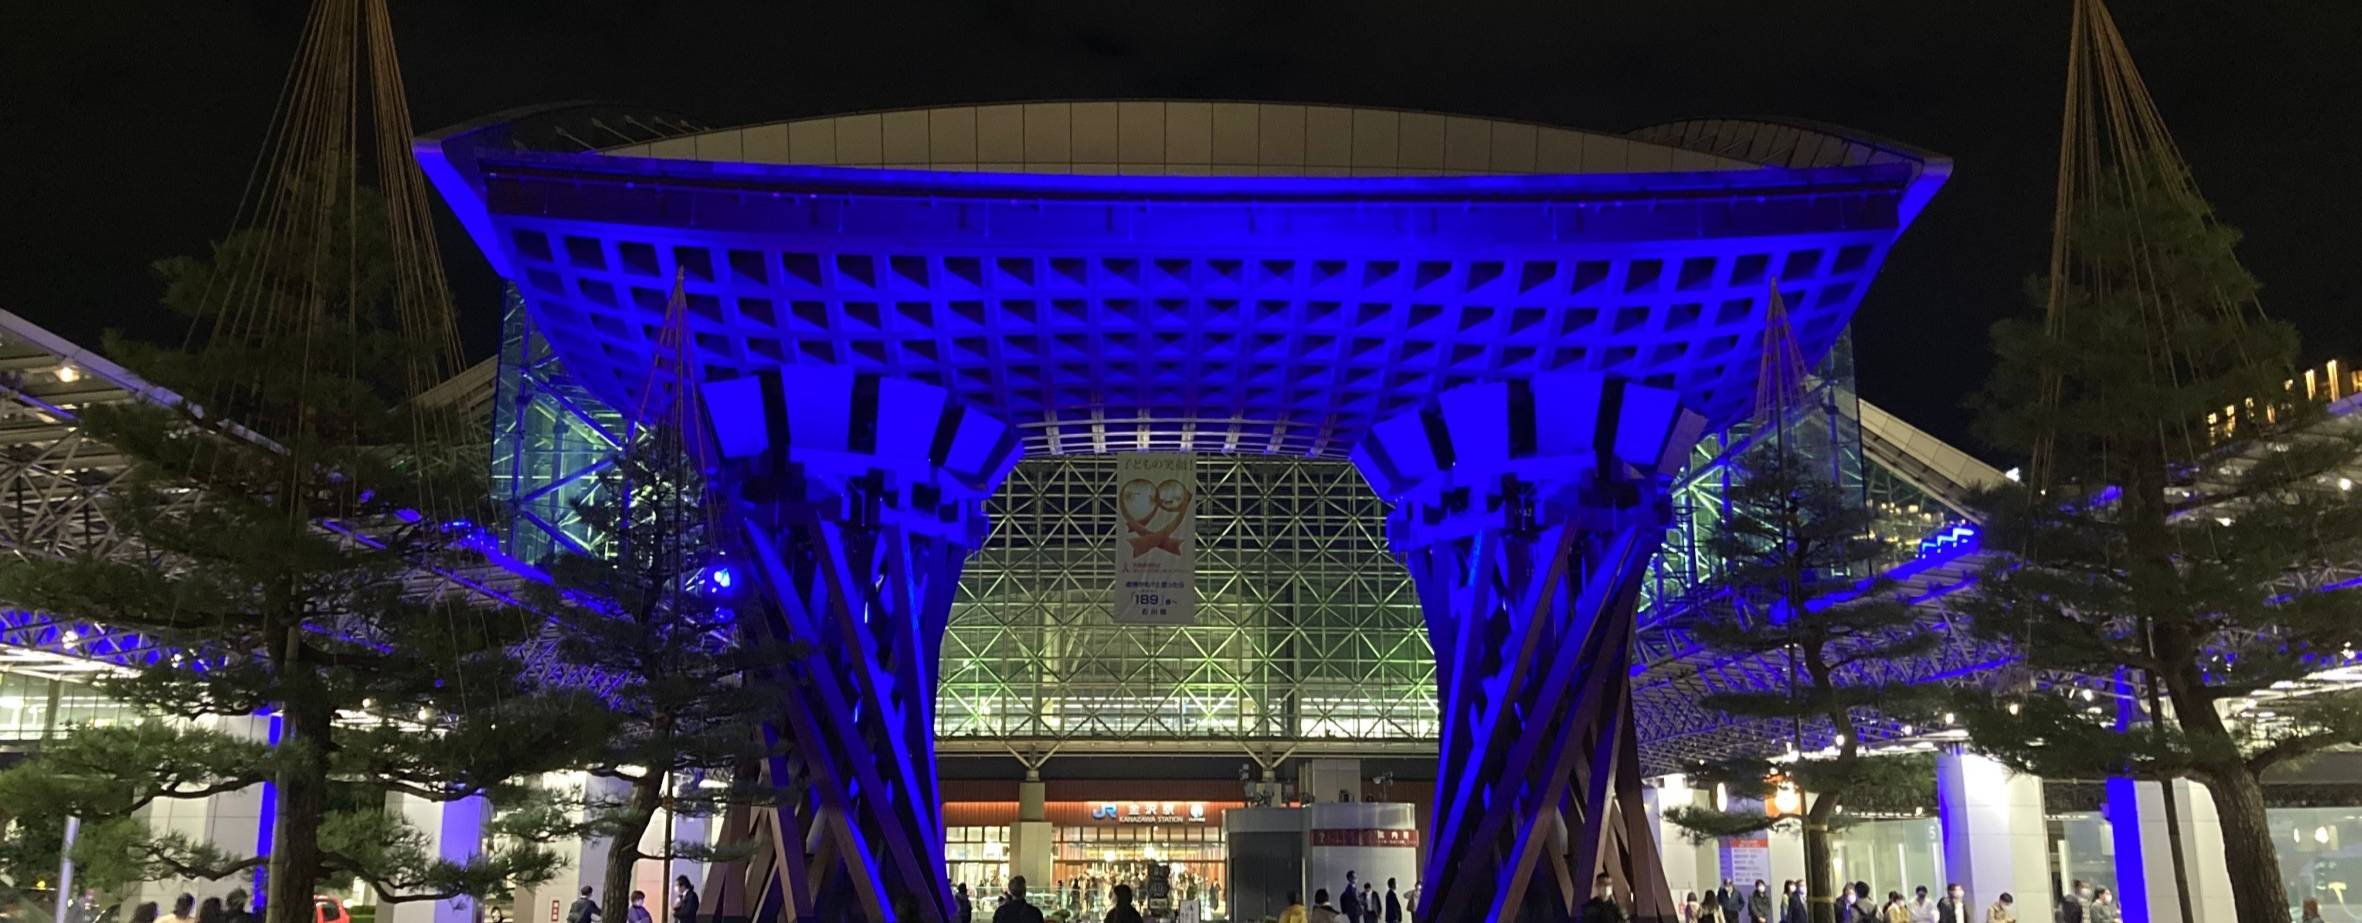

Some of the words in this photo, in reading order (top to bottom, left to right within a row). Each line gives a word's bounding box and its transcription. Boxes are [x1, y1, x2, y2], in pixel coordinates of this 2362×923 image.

[1092, 802, 1118, 820] JR
[1128, 802, 1175, 816] 金沢駅
